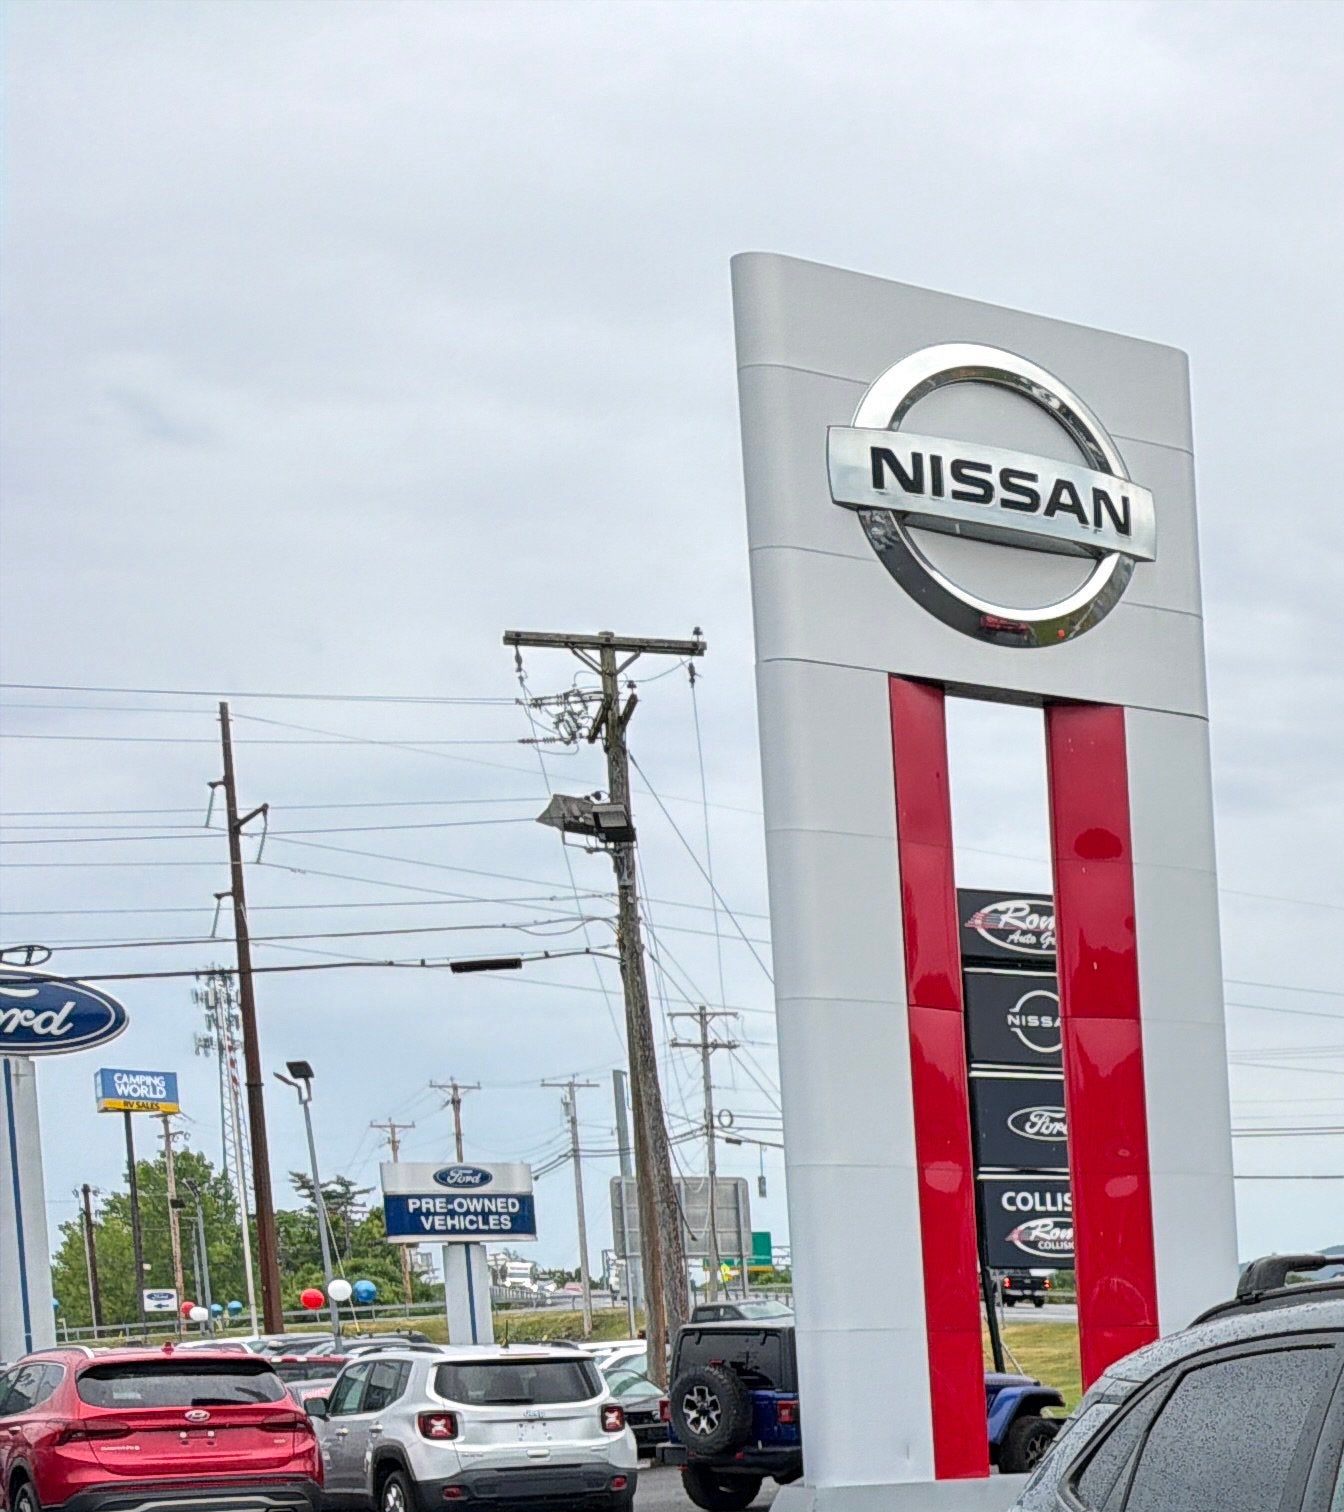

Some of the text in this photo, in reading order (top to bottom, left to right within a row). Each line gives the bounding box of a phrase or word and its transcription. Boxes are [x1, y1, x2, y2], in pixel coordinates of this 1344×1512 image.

[869, 446, 1132, 537] NISSAN
[1006, 930, 1037, 943] Auto
[0, 986, 76, 1036] rd
[113, 1072, 165, 1087] CAMPING
[115, 1084, 166, 1099] WORLD
[135, 1101, 160, 1110] SALES
[1024, 1110, 1067, 1134] For
[447, 1169, 482, 1185] Ford
[407, 1197, 520, 1213] PRE-OWNED
[420, 1214, 512, 1231] VEHICLES
